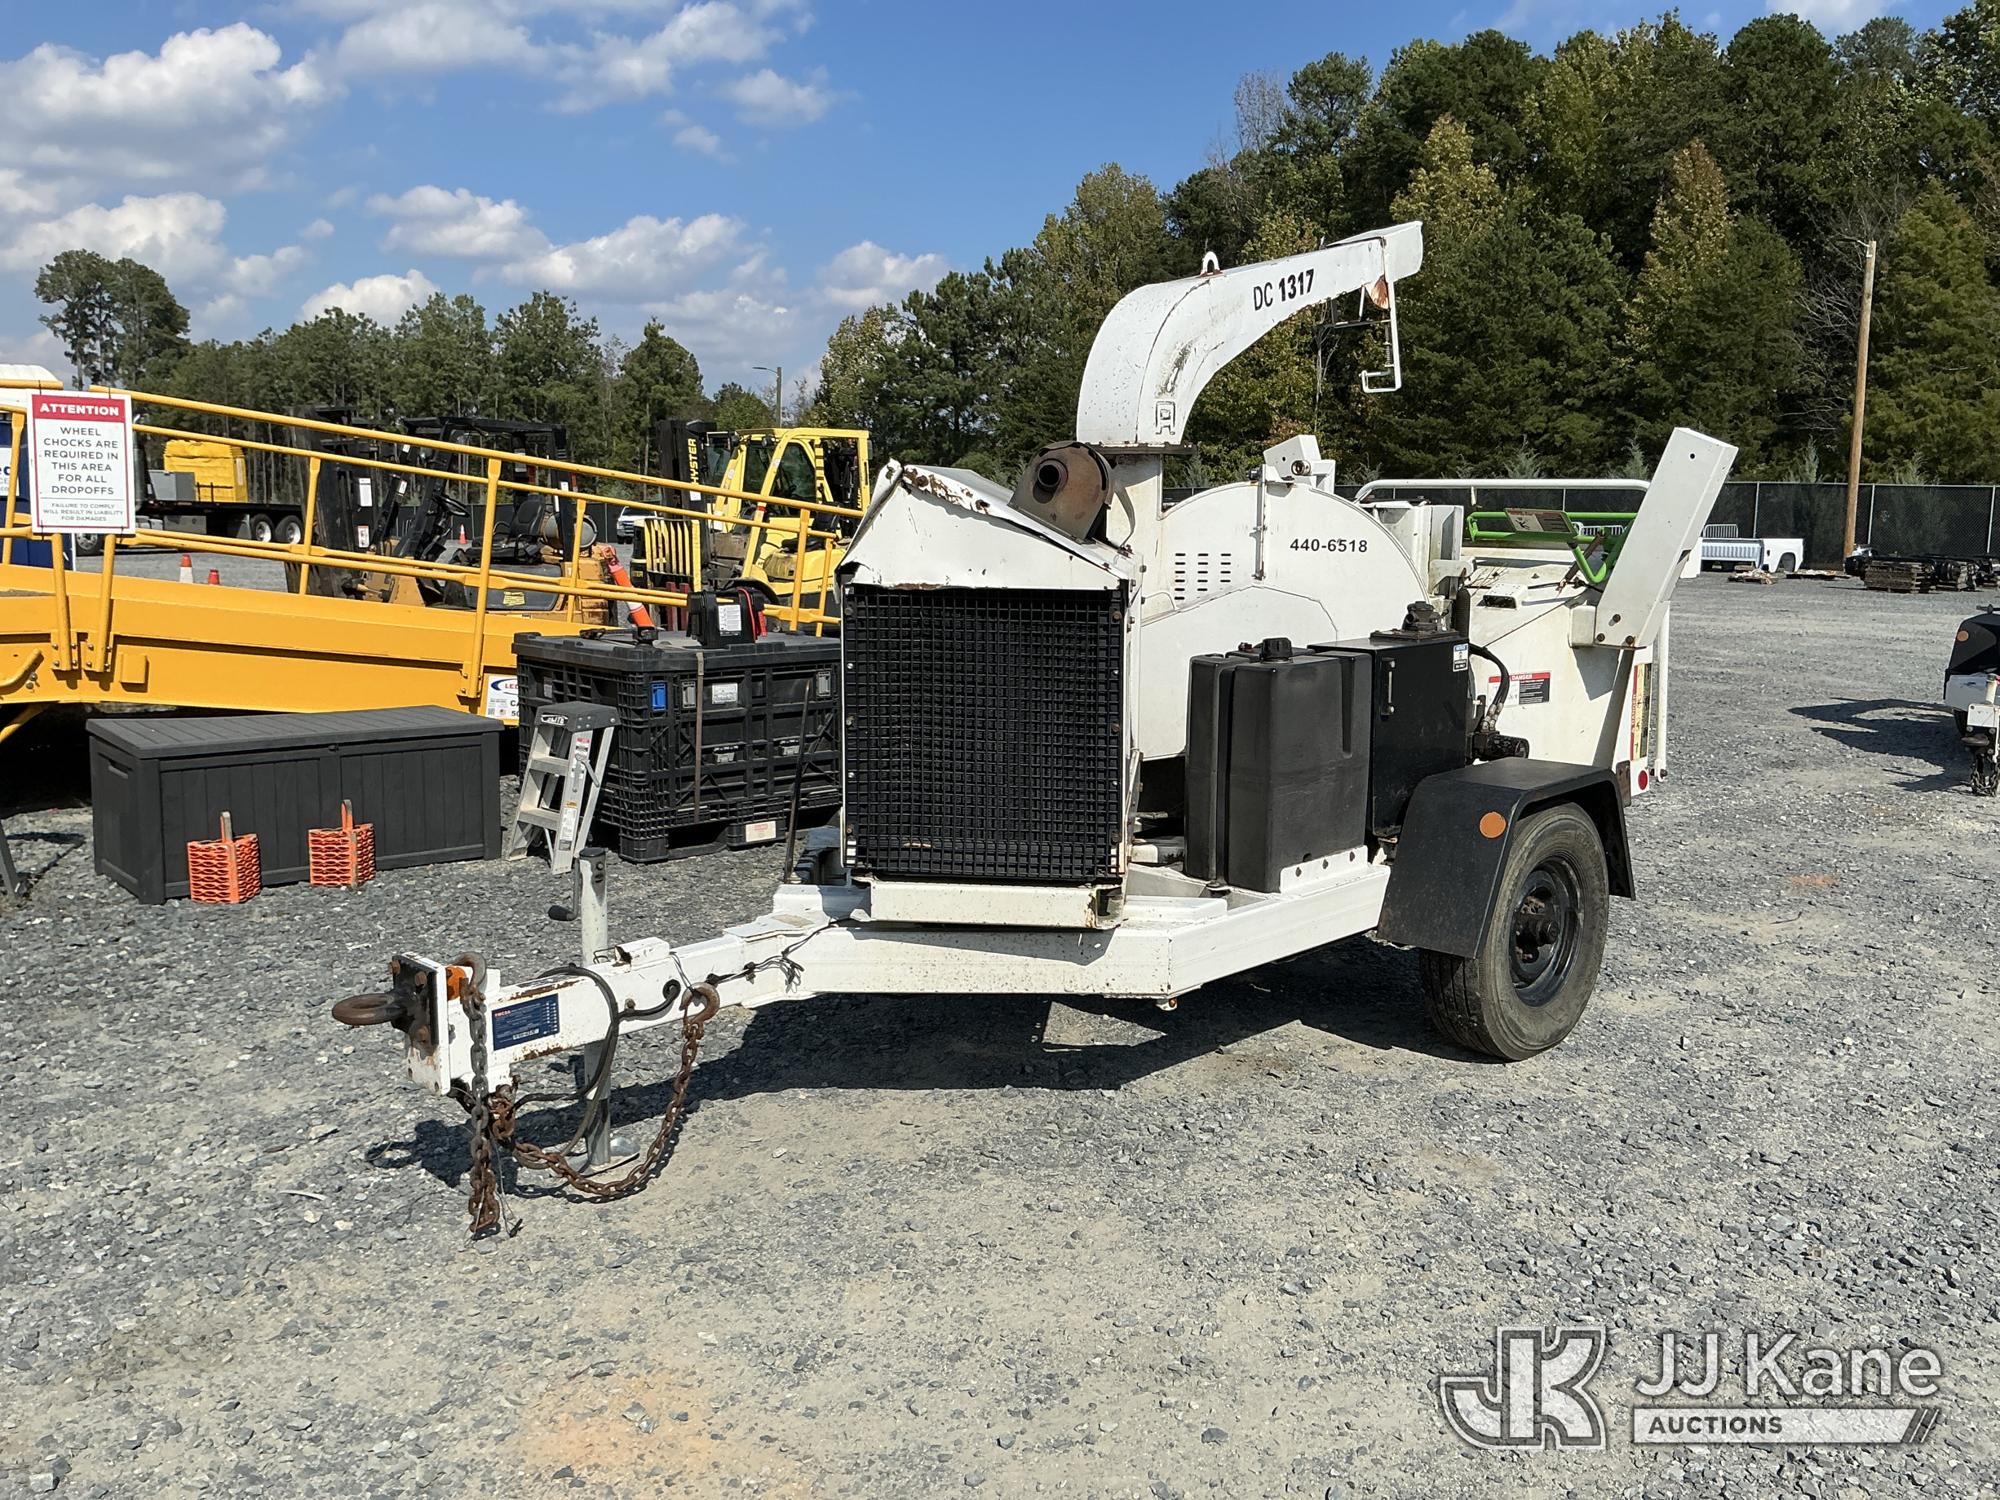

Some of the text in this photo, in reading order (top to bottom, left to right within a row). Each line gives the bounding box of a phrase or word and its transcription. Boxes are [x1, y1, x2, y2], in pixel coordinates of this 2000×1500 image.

[1253, 268, 1314, 311] DC 1317
[40, 403, 119, 416] ATTENTION
[60, 427, 101, 436] WHEEL
[43, 438, 118, 448] CHOCKS ARE
[44, 450, 103, 460] REQUIRED
[51, 462, 112, 471] THIS AREA
[687, 438, 699, 486] HYSTER
[58, 474, 107, 483] FOR ALL
[51, 486, 114, 495] DROPOFFS
[1289, 538, 1368, 553] 440-6518
